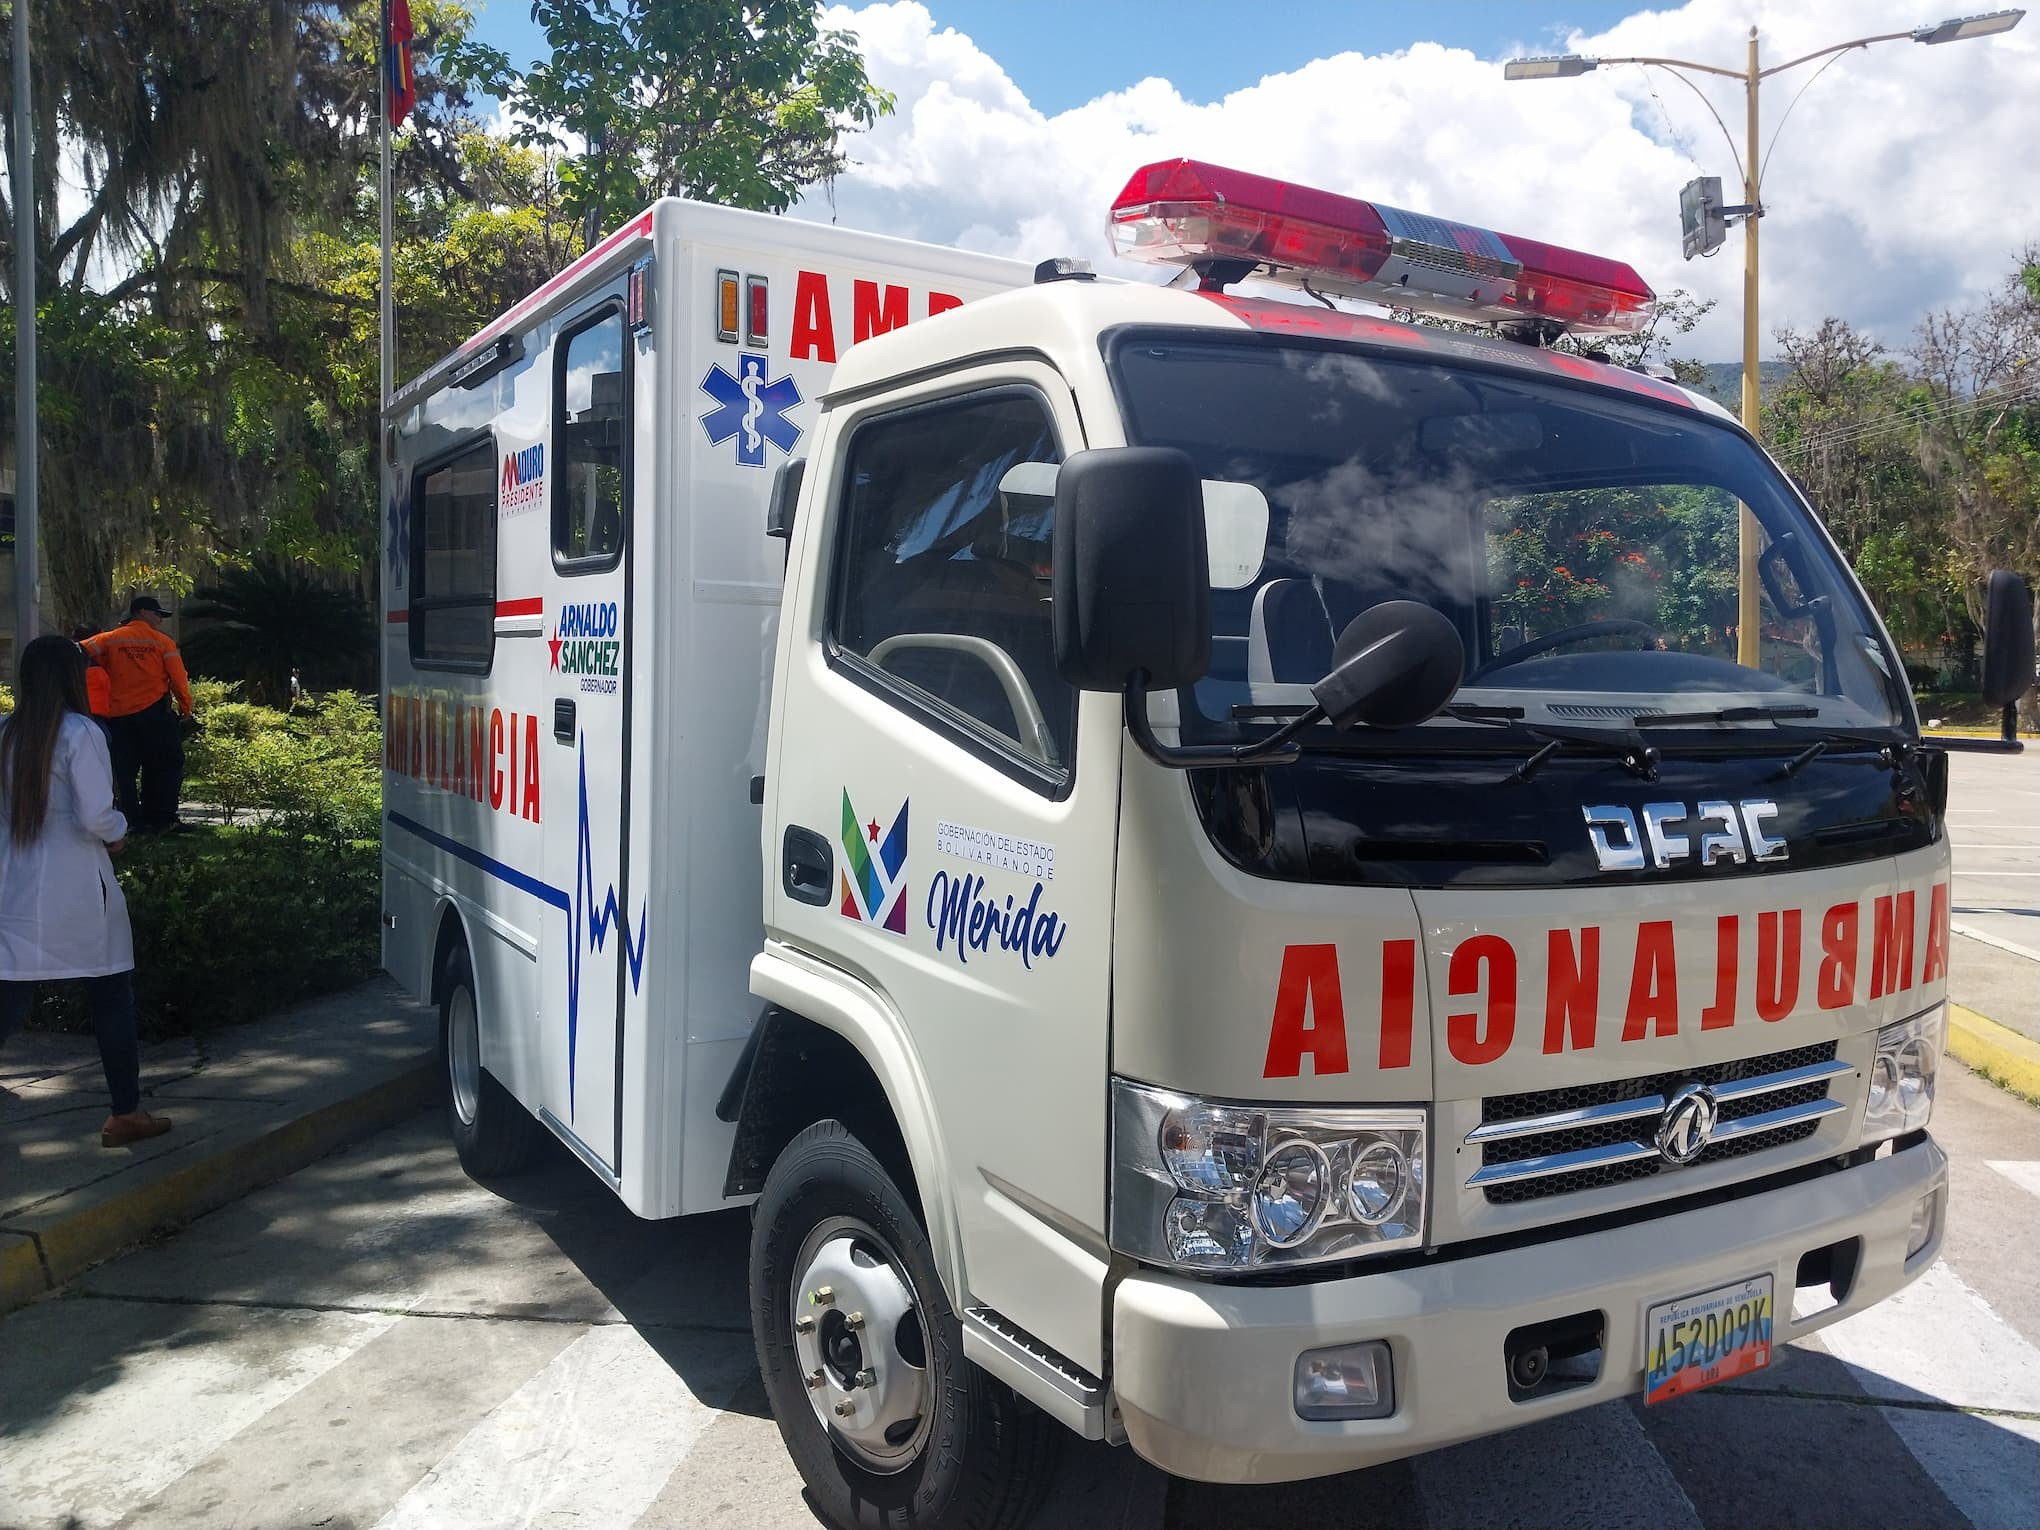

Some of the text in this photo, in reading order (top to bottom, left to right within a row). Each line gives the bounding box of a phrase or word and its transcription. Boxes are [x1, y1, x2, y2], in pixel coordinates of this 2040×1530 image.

[790, 270, 965, 364] AM
[502, 442, 544, 494] MADURO
[502, 481, 544, 509] PRESIDENTE
[559, 602, 617, 638] ARNALDO
[580, 678, 617, 695] GOBERNADOR
[386, 694, 540, 824] AMBULANCIA
[937, 839, 1054, 880] BOLIVARIANO DE
[998, 837, 1015, 854] DEL
[1016, 841, 1055, 862] ESTADO
[926, 870, 1067, 970] Mérida
